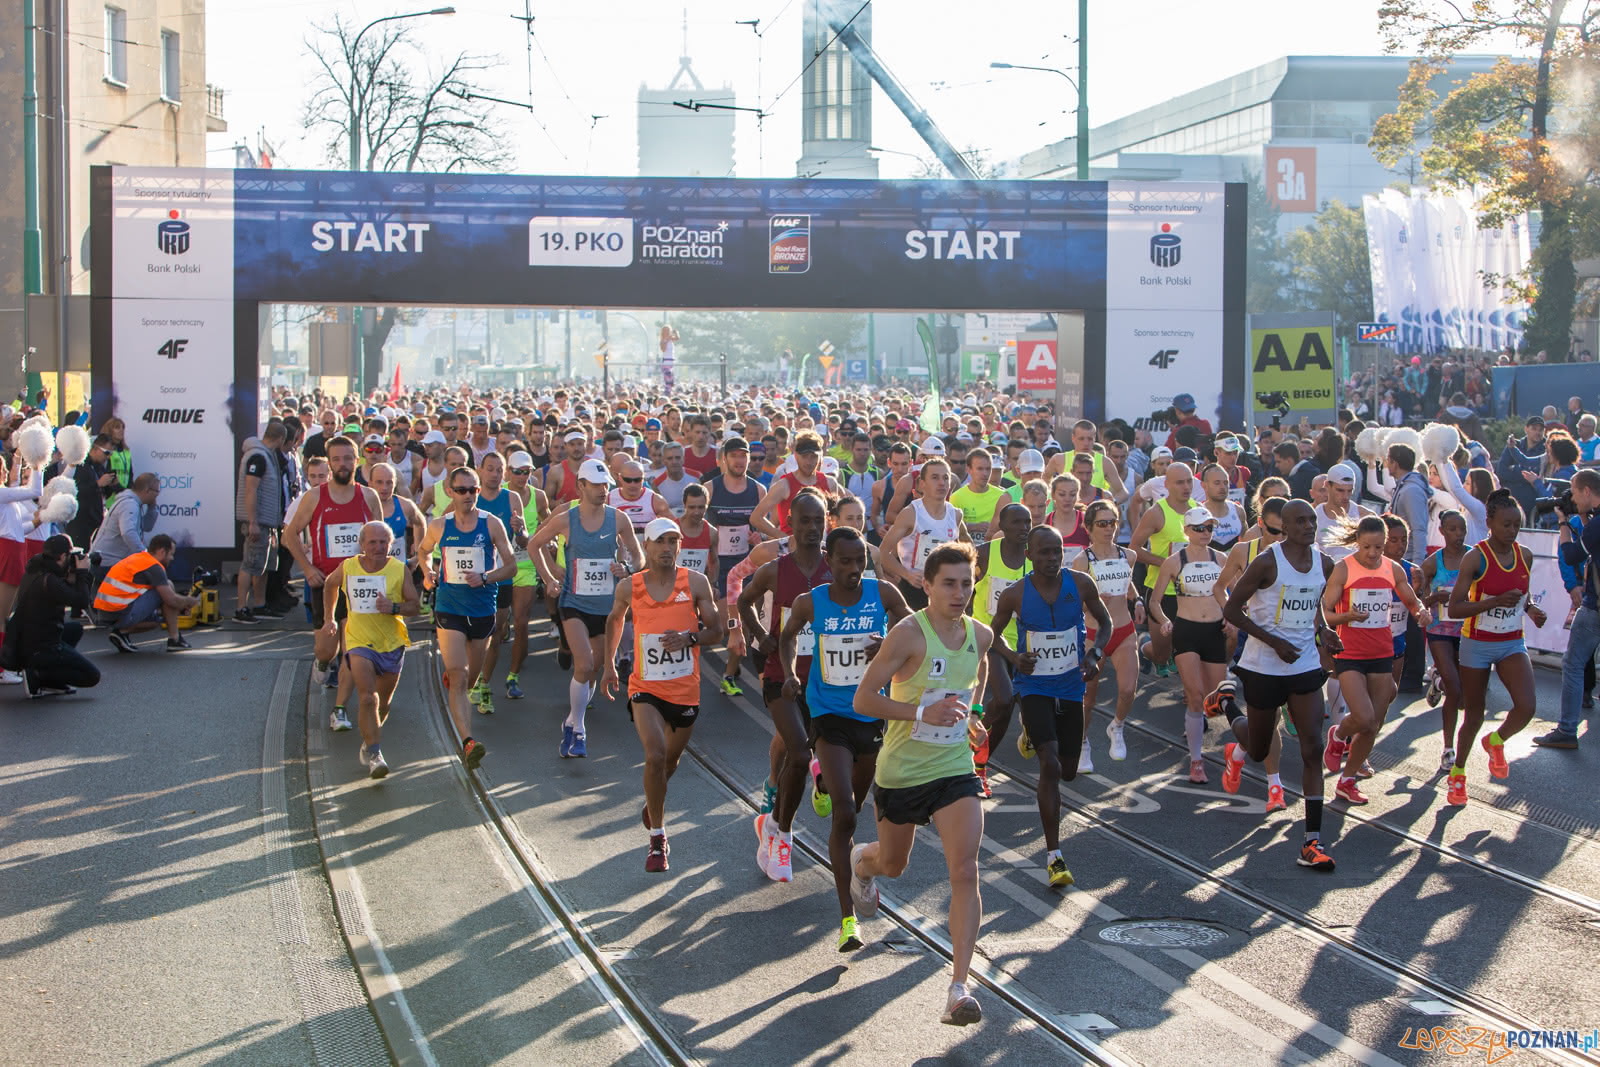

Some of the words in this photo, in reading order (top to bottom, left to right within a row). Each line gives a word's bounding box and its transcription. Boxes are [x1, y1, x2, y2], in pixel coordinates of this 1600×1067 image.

[1277, 158, 1306, 201] 3A
[134, 188, 170, 198] Sponsor
[172, 190, 212, 199] tytularny
[1128, 203, 1162, 212] Sponsor
[1165, 204, 1203, 213] tytularny
[773, 219, 801, 227] IAAF
[312, 220, 430, 253] START
[539, 231, 569, 251] 19.
[575, 231, 624, 252] PKO
[904, 229, 1021, 260] START
[642, 243, 724, 258] maraton
[773, 253, 806, 261] BRONZE
[147, 264, 171, 273] Bank
[174, 264, 201, 274] Polski
[1140, 276, 1163, 286] Bank
[1166, 277, 1192, 286] Polski
[141, 318, 168, 327] Sponsor
[170, 319, 205, 328] techniczny
[1133, 329, 1160, 337] Sponsor
[1160, 330, 1195, 339] techniczny
[1359, 325, 1397, 341] TAXI
[158, 339, 189, 359] 4F
[1253, 332, 1332, 372] AA
[1026, 343, 1057, 371] A
[1148, 350, 1180, 369] 4F
[160, 386, 187, 394] Sponsor
[1293, 389, 1331, 399] BIEGU
[142, 408, 205, 424] 4MOVE
[150, 450, 197, 459] Organizatorzy
[334, 534, 358, 544] 5380
[730, 536, 741, 544] 49
[455, 560, 474, 569] 183
[584, 571, 607, 581] 3631
[1185, 572, 1221, 584] DZIĘGIE
[353, 588, 378, 598] 3875
[1486, 607, 1516, 620] LEMA
[824, 615, 874, 632] 海尔斯
[647, 647, 691, 665] SAJI
[1033, 643, 1077, 660] KYEVA
